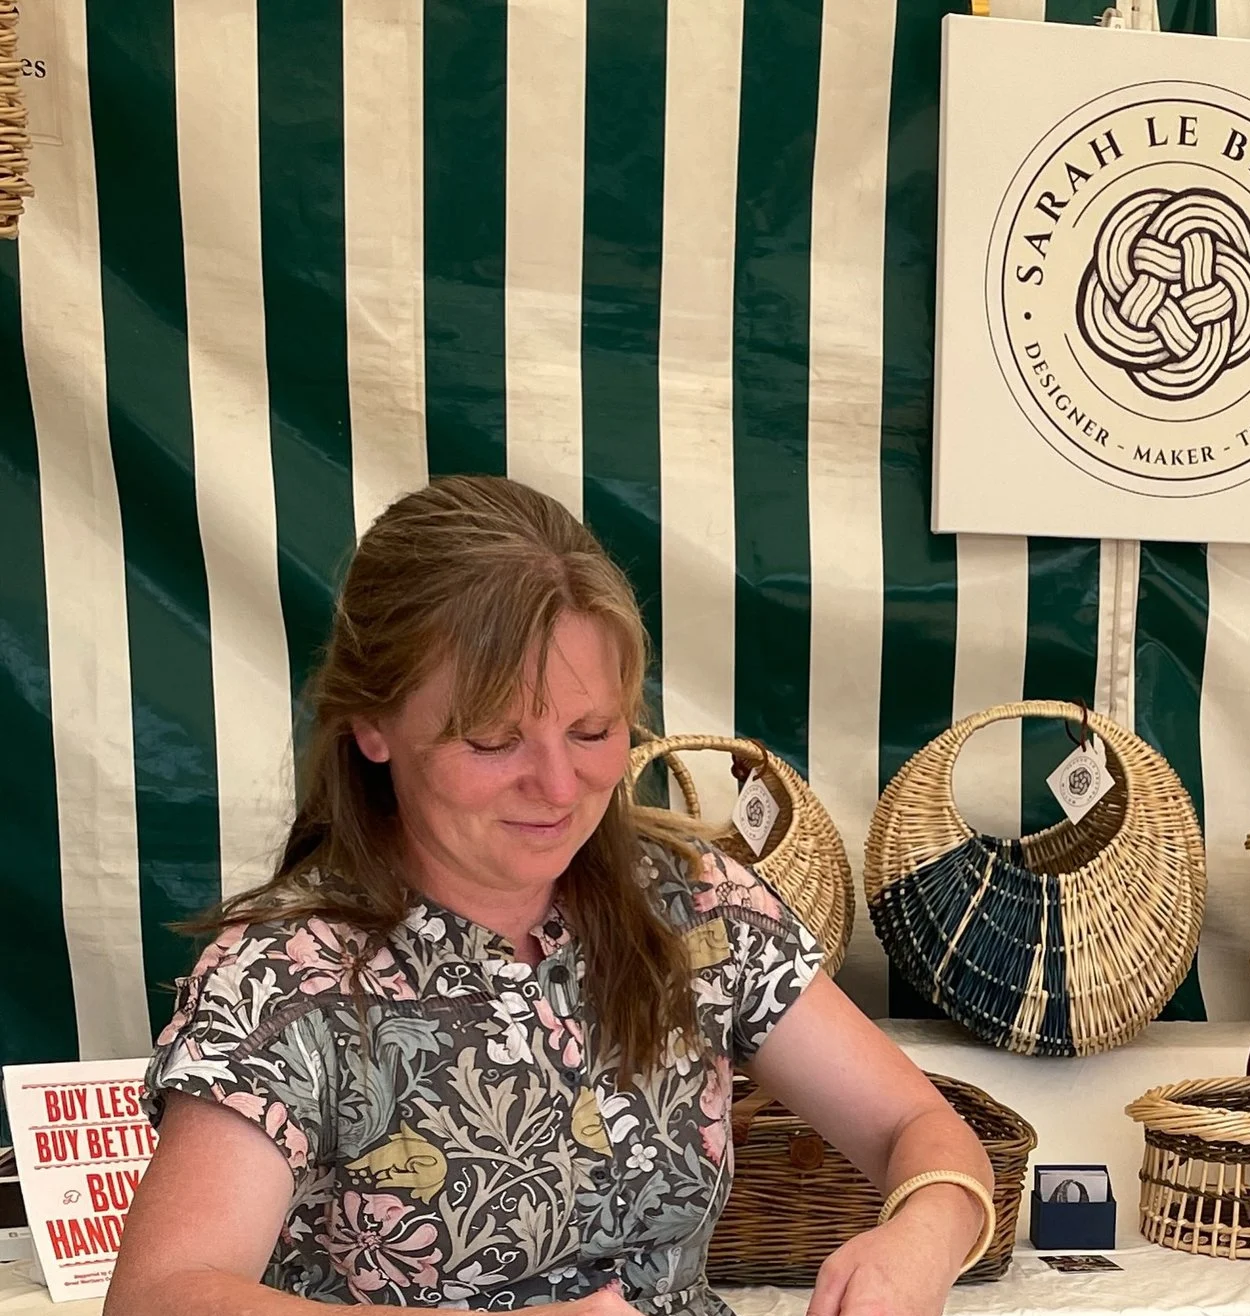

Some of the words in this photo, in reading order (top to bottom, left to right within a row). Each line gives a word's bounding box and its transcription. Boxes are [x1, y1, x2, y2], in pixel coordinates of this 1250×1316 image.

[1016, 129, 1125, 286] SARAH
[1145, 115, 1199, 147] LE
[1024, 341, 1110, 447] DESIGNER
[1133, 445, 1216, 466] MAKER
[44, 1088, 87, 1122] BUY
[35, 1129, 79, 1163] BUY
[86, 1170, 140, 1213] BUY
[46, 1215, 127, 1260] HAND
